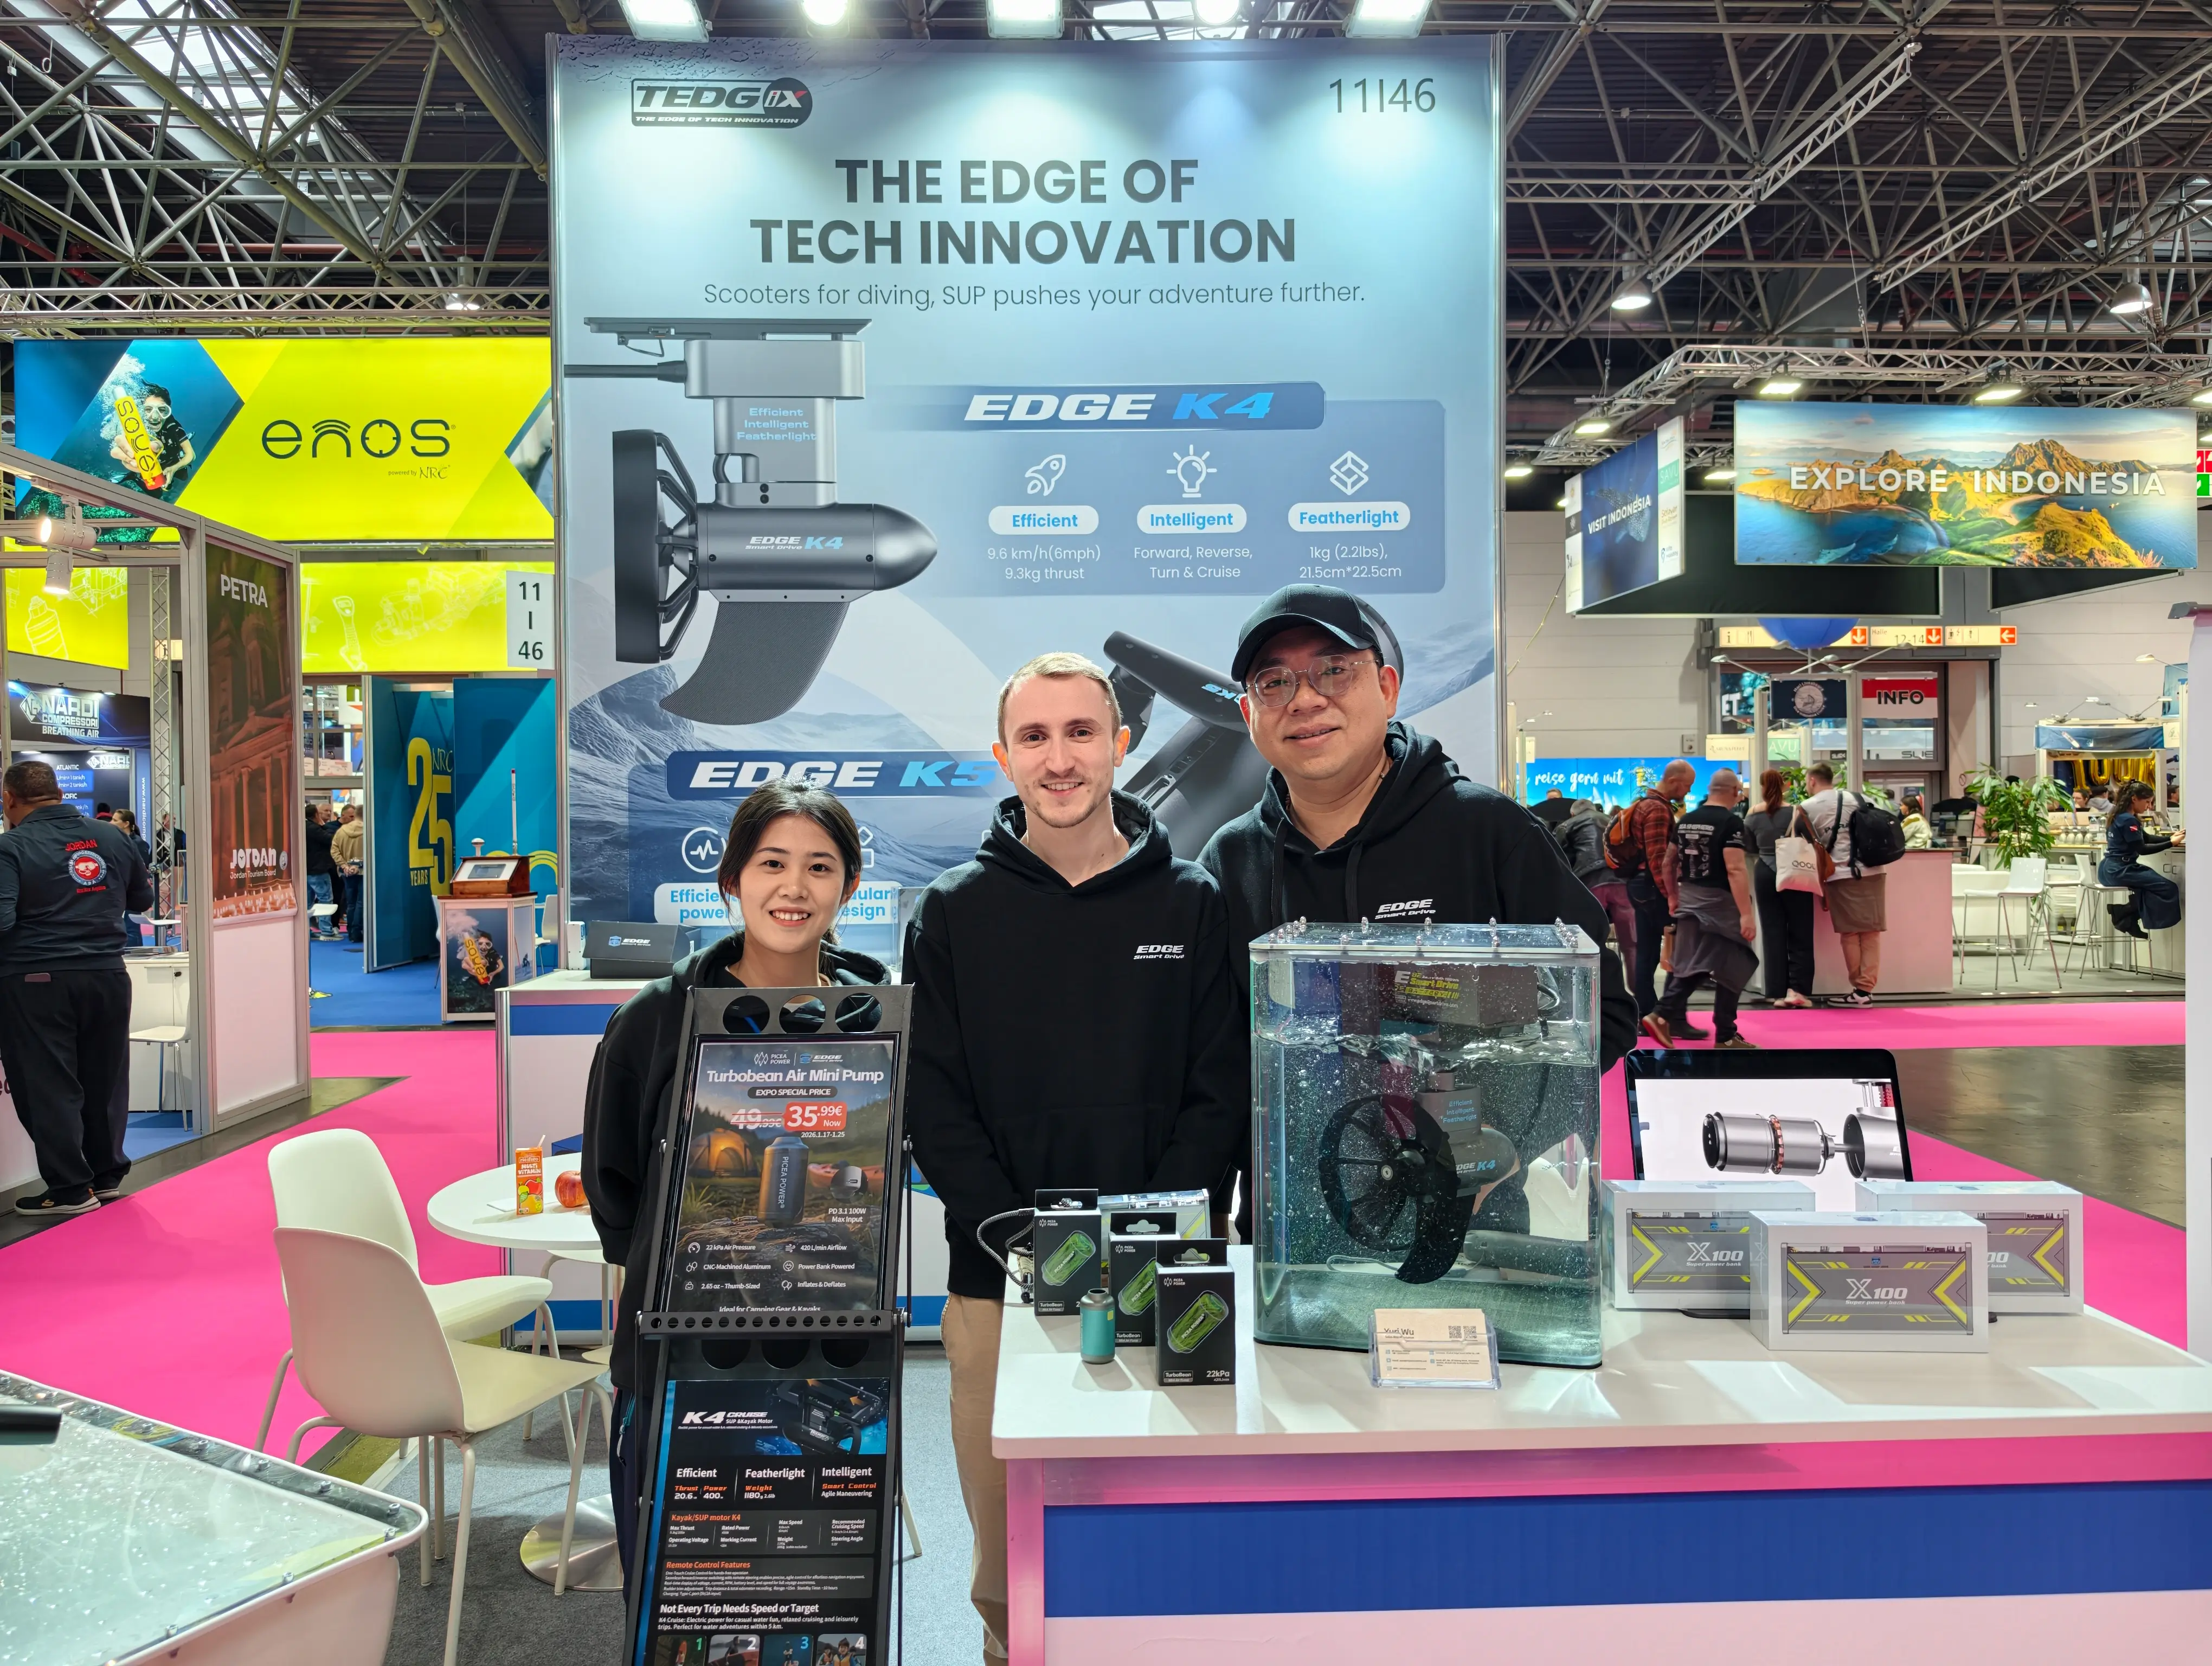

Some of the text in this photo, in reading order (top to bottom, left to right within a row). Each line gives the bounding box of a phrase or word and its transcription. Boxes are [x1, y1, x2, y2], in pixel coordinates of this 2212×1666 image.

[835, 159, 1199, 204] THE EDGE OF
[750, 219, 1295, 265] TECH INNOVATION
[704, 282, 1365, 312] Scooters for diving, SUP pushes your adventure further.
[749, 407, 803, 417] Efficient
[964, 392, 1275, 420] EDGE K4
[743, 420, 809, 430] Intelligent
[736, 431, 816, 441] Featherlight
[1790, 466, 2166, 496] EXPLORE INDONESIA
[1012, 510, 1399, 530] Efficient Intelligent Featherlight
[1588, 494, 1652, 534] VISIT INDONESIA
[749, 536, 844, 549] EDGE K4
[987, 543, 1388, 562] 9.6 km/h(6mph) Forward, Reverse, 1kg (2.2lbs),
[1005, 567, 1040, 583] 9.3kg
[1044, 567, 1085, 579] thrust
[1149, 567, 1180, 579] Turn
[1184, 567, 1194, 578] &
[1197, 566, 1241, 579] Cruise
[221, 573, 268, 608] PETRA
[518, 581, 541, 601] 11
[1894, 634, 1925, 644] 12-14
[518, 640, 544, 661] 46
[41, 694, 99, 718] NARDI
[1876, 690, 1925, 706] INFO
[41, 715, 98, 728] COMPRESSORI
[42, 725, 99, 738] BREATHING AIR
[1769, 740, 1797, 753] AVU
[432, 747, 453, 773] NRC
[689, 761, 999, 789] EDGE K5
[1535, 768, 1625, 792] reise gern mit
[230, 868, 276, 879] Jordan Tourism Board
[410, 869, 428, 886] YEARS
[671, 889, 728, 903] Efficie
[839, 902, 886, 921] esign
[1374, 908, 1436, 920] Smart Drive
[1377, 898, 1434, 913] EDGE
[1136, 944, 1185, 954] EDGE
[706, 1068, 884, 1085] Turbobean Air Mini Pump
[780, 1156, 789, 1177] PICEA
[1456, 1162, 1476, 1171] DGE
[1476, 1159, 1496, 1172] K4
[1686, 1241, 1744, 1262] X100
[1845, 1278, 1908, 1300] X100
[1206, 1370, 1230, 1379] 22kPa
[681, 1411, 726, 1424] K4
[676, 1466, 872, 1481] Efficient Featherlight Intelligent
[671, 1514, 709, 1522] Kayak/SUP
[660, 1604, 677, 1613] Not
[677, 1604, 703, 1615] Every
[703, 1603, 722, 1614] Trip
[722, 1603, 750, 1613] Needs
[750, 1603, 779, 1614] Speed
[790, 1603, 820, 1614] Target
[696, 1636, 865, 1651] 1 2 3 4
